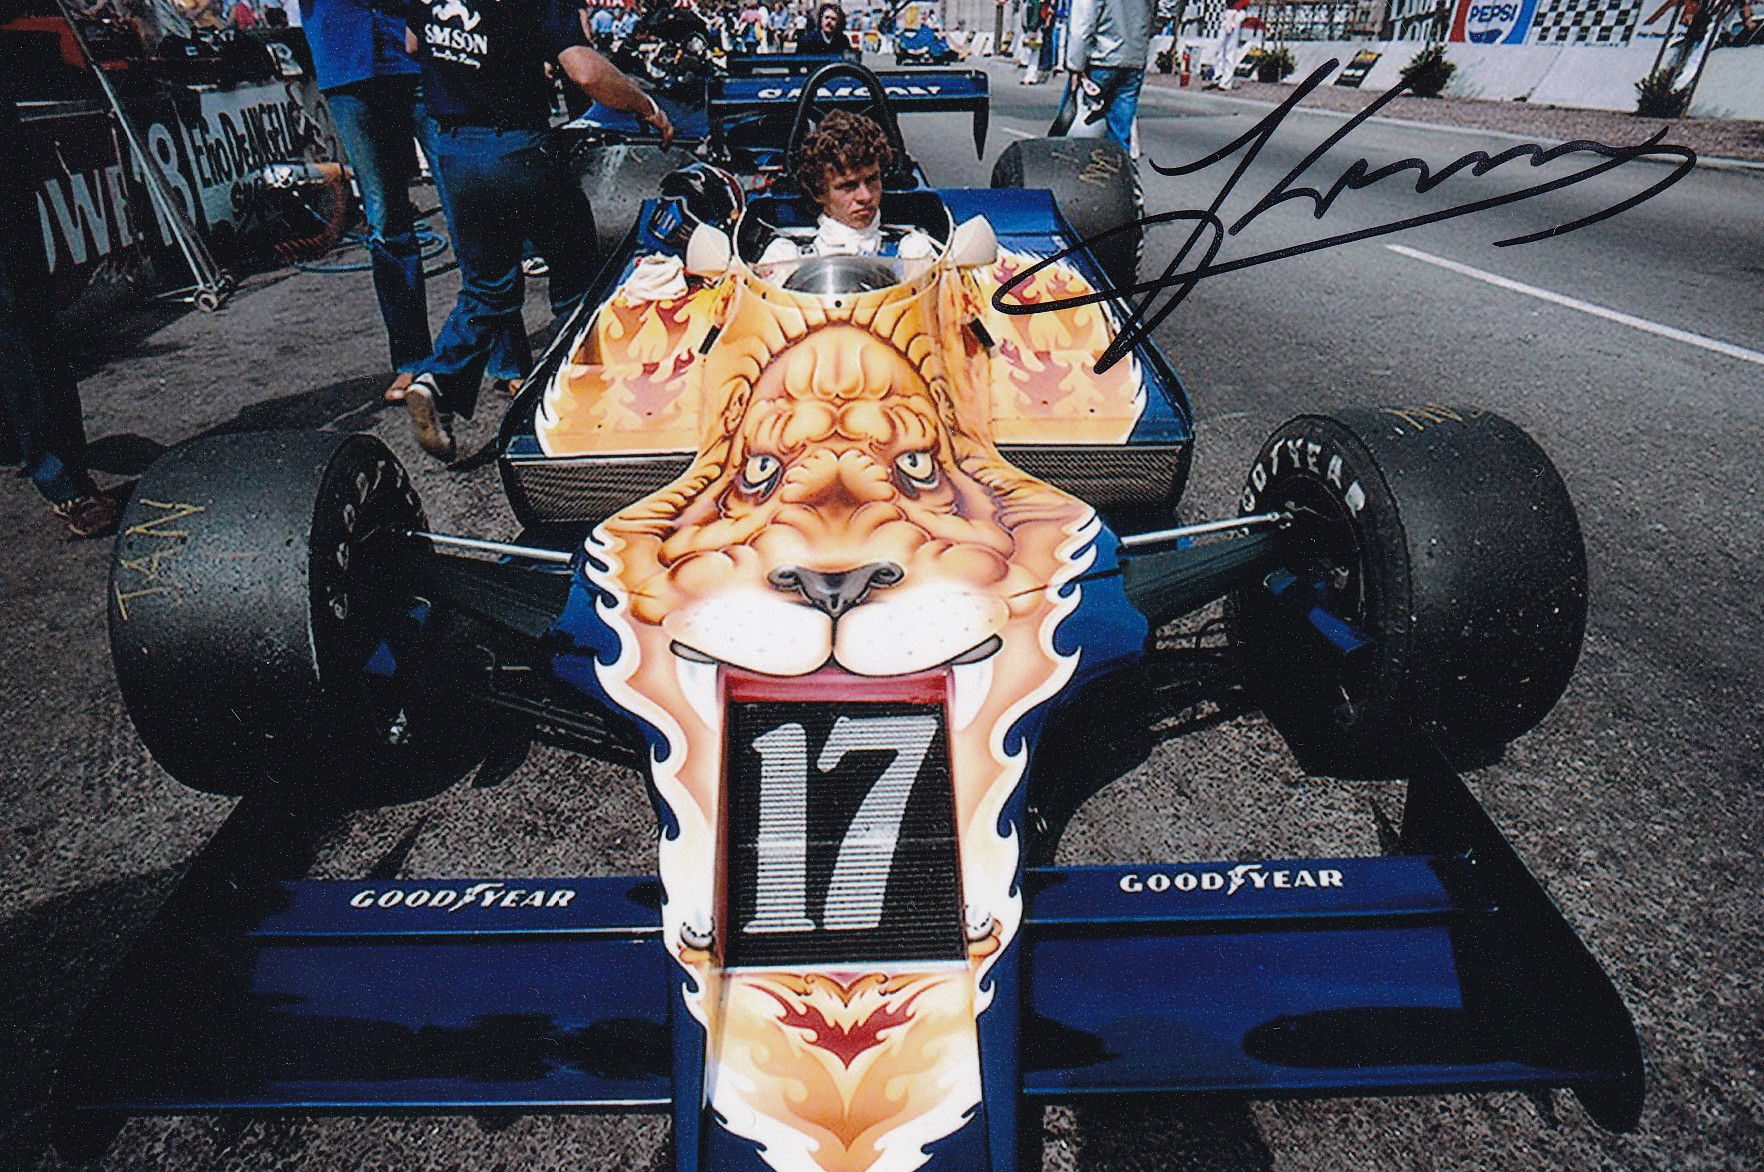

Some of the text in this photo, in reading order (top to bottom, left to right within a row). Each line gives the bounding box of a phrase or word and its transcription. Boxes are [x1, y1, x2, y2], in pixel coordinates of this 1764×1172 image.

[1468, 4, 1518, 22] PEPSI
[742, 714, 940, 934] 17
[1119, 865, 1344, 895] GOODYEAR
[350, 885, 576, 911] GOODYEAR
